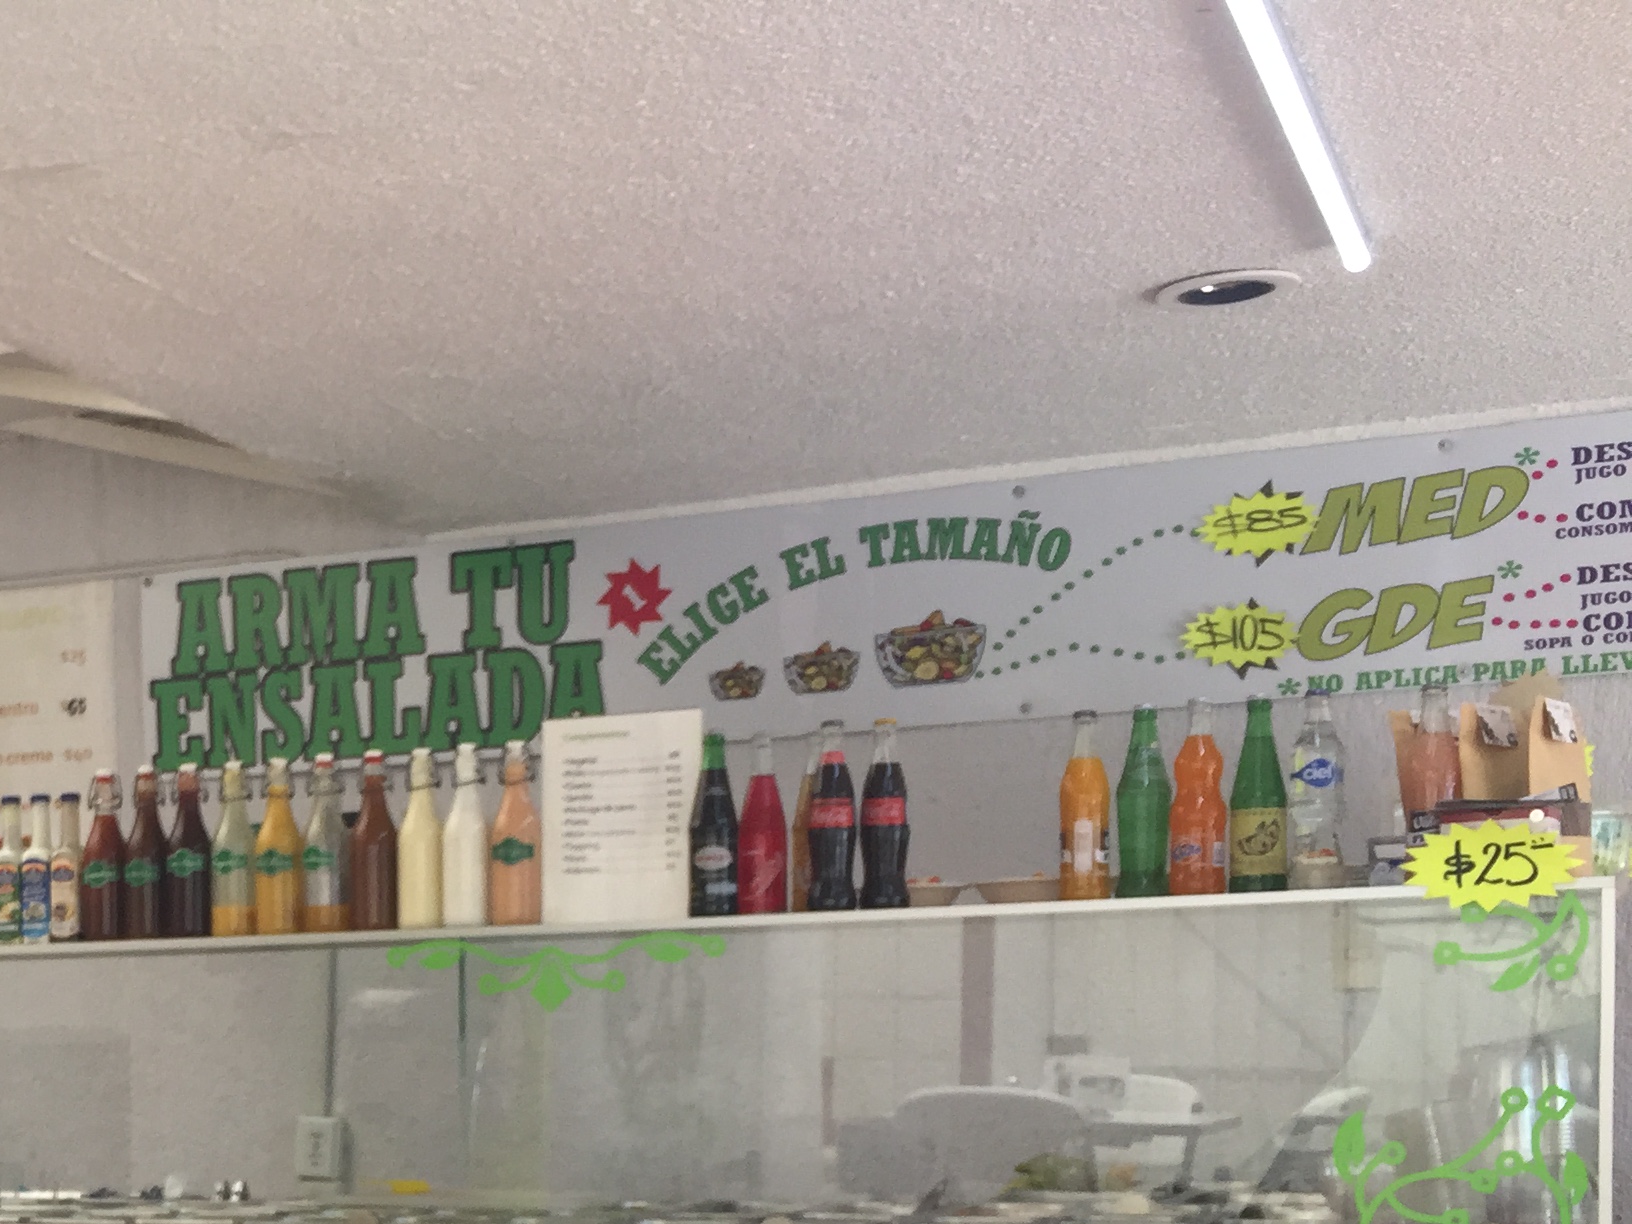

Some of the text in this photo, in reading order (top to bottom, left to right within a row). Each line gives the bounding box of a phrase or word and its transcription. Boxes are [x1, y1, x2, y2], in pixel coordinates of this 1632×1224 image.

[1213, 465, 1531, 555] $85 MED
[1575, 464, 1627, 484] JUGO
[170, 540, 575, 677] ARMA TU
[637, 510, 1072, 686] ELIGE EL TAMAÑO
[1196, 575, 1495, 662] $105 GDE
[1580, 590, 1632, 610] JUGO
[1307, 673, 1344, 693] NO
[1355, 665, 1461, 691] APLICA
[1472, 657, 1546, 682] PARA
[1524, 636, 1572, 650] SOPA
[1581, 634, 1594, 645] O
[150, 640, 605, 773] ENSALADA
